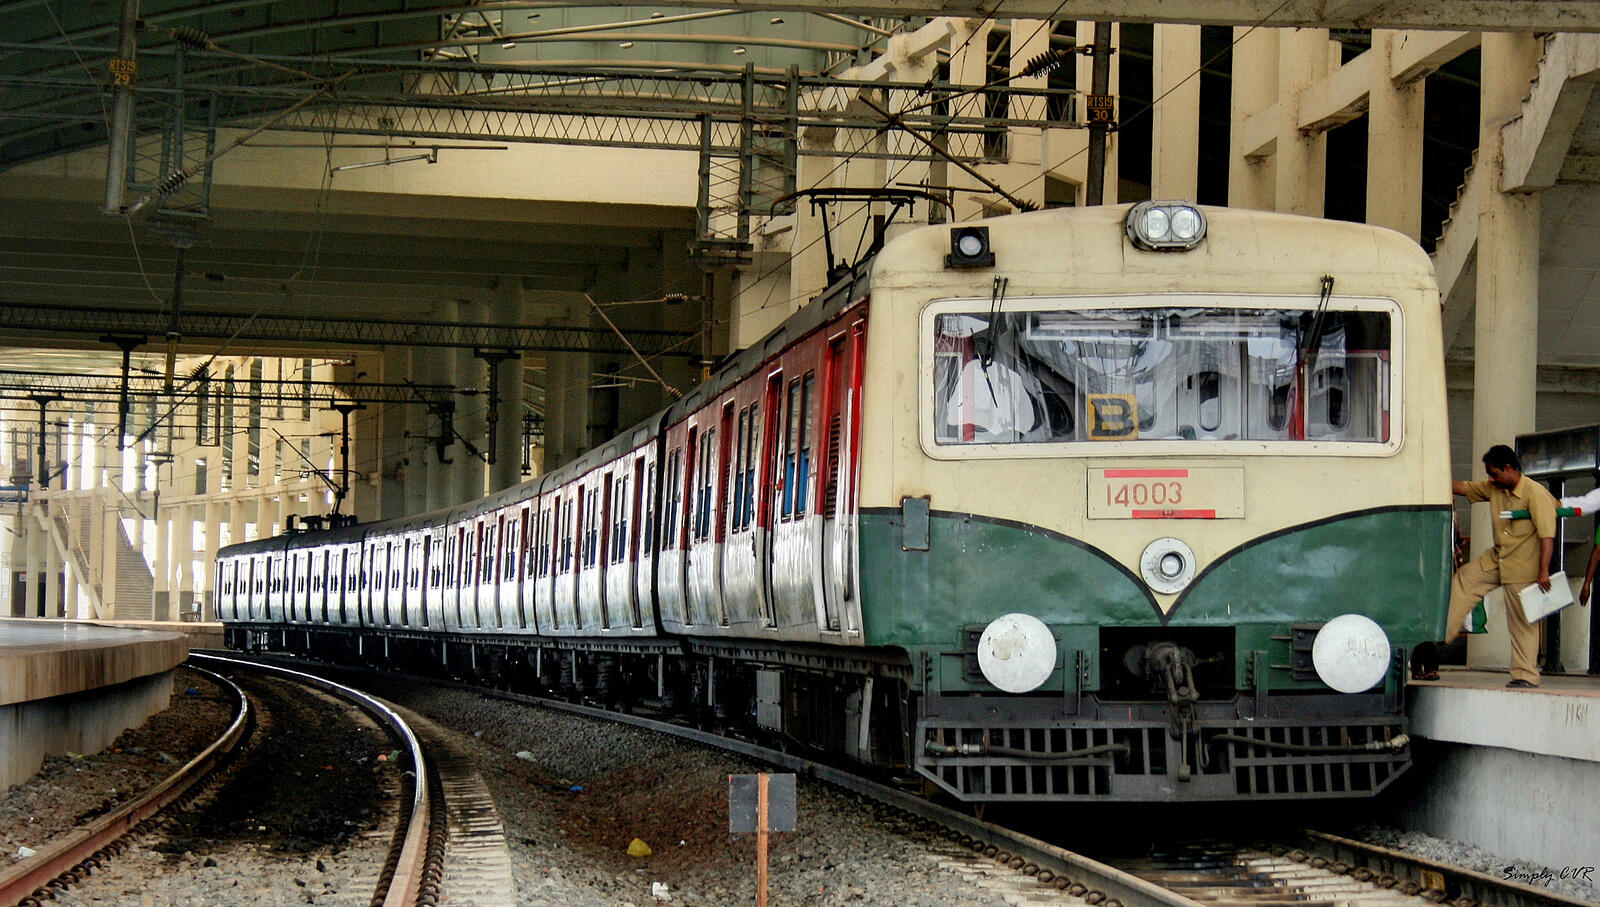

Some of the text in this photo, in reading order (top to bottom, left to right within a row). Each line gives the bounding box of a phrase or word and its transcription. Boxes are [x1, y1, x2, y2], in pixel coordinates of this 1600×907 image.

[1087, 96, 1113, 108] RTS19
[1093, 109, 1108, 121] 30
[1091, 398, 1134, 437] B
[1106, 481, 1182, 507] 14003
